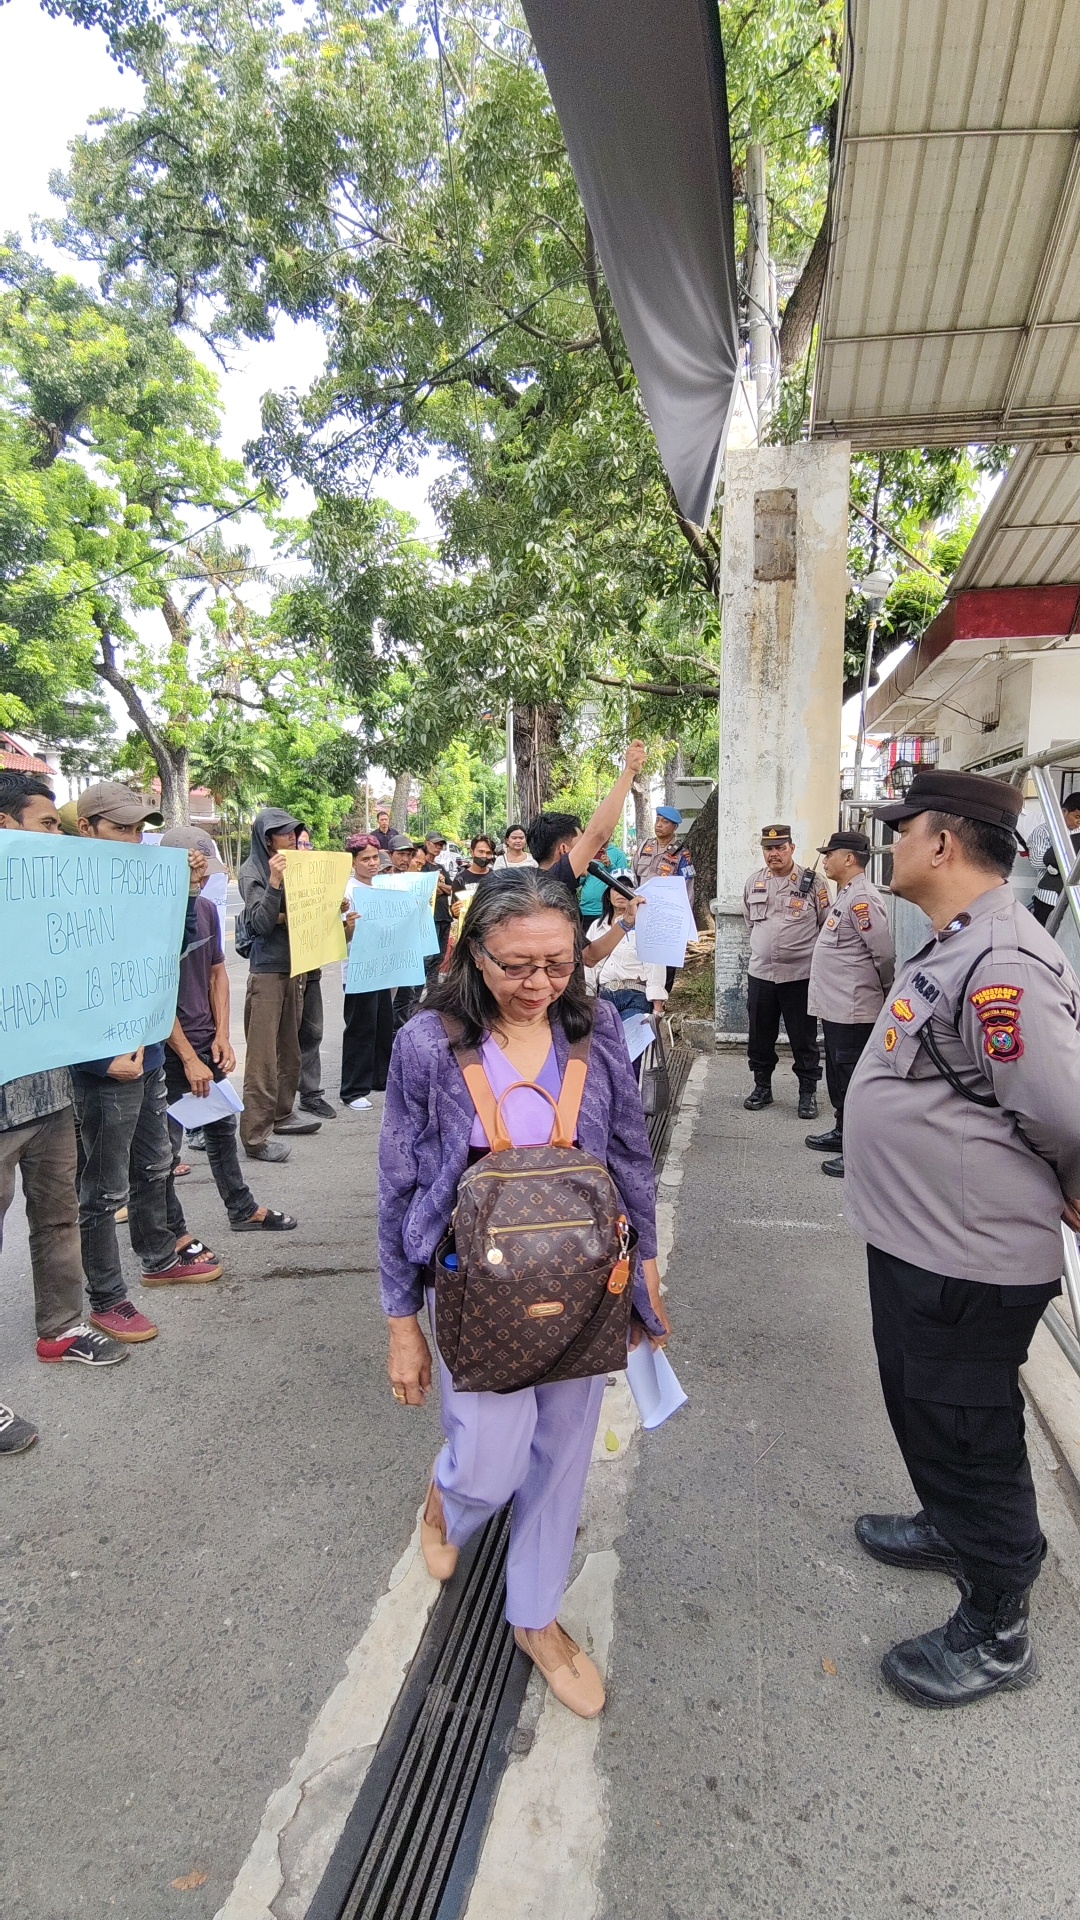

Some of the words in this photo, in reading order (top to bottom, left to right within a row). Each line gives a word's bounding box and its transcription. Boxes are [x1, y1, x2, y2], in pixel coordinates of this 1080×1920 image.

[110, 857, 178, 898] PASOKAN
[790, 890, 808, 899] POLRI
[47, 904, 116, 955] BAHAN
[297, 925, 319, 955] YANG
[0, 976, 67, 1032] HADAP
[78, 966, 104, 1012] 18
[911, 971, 940, 1004] POLRI
